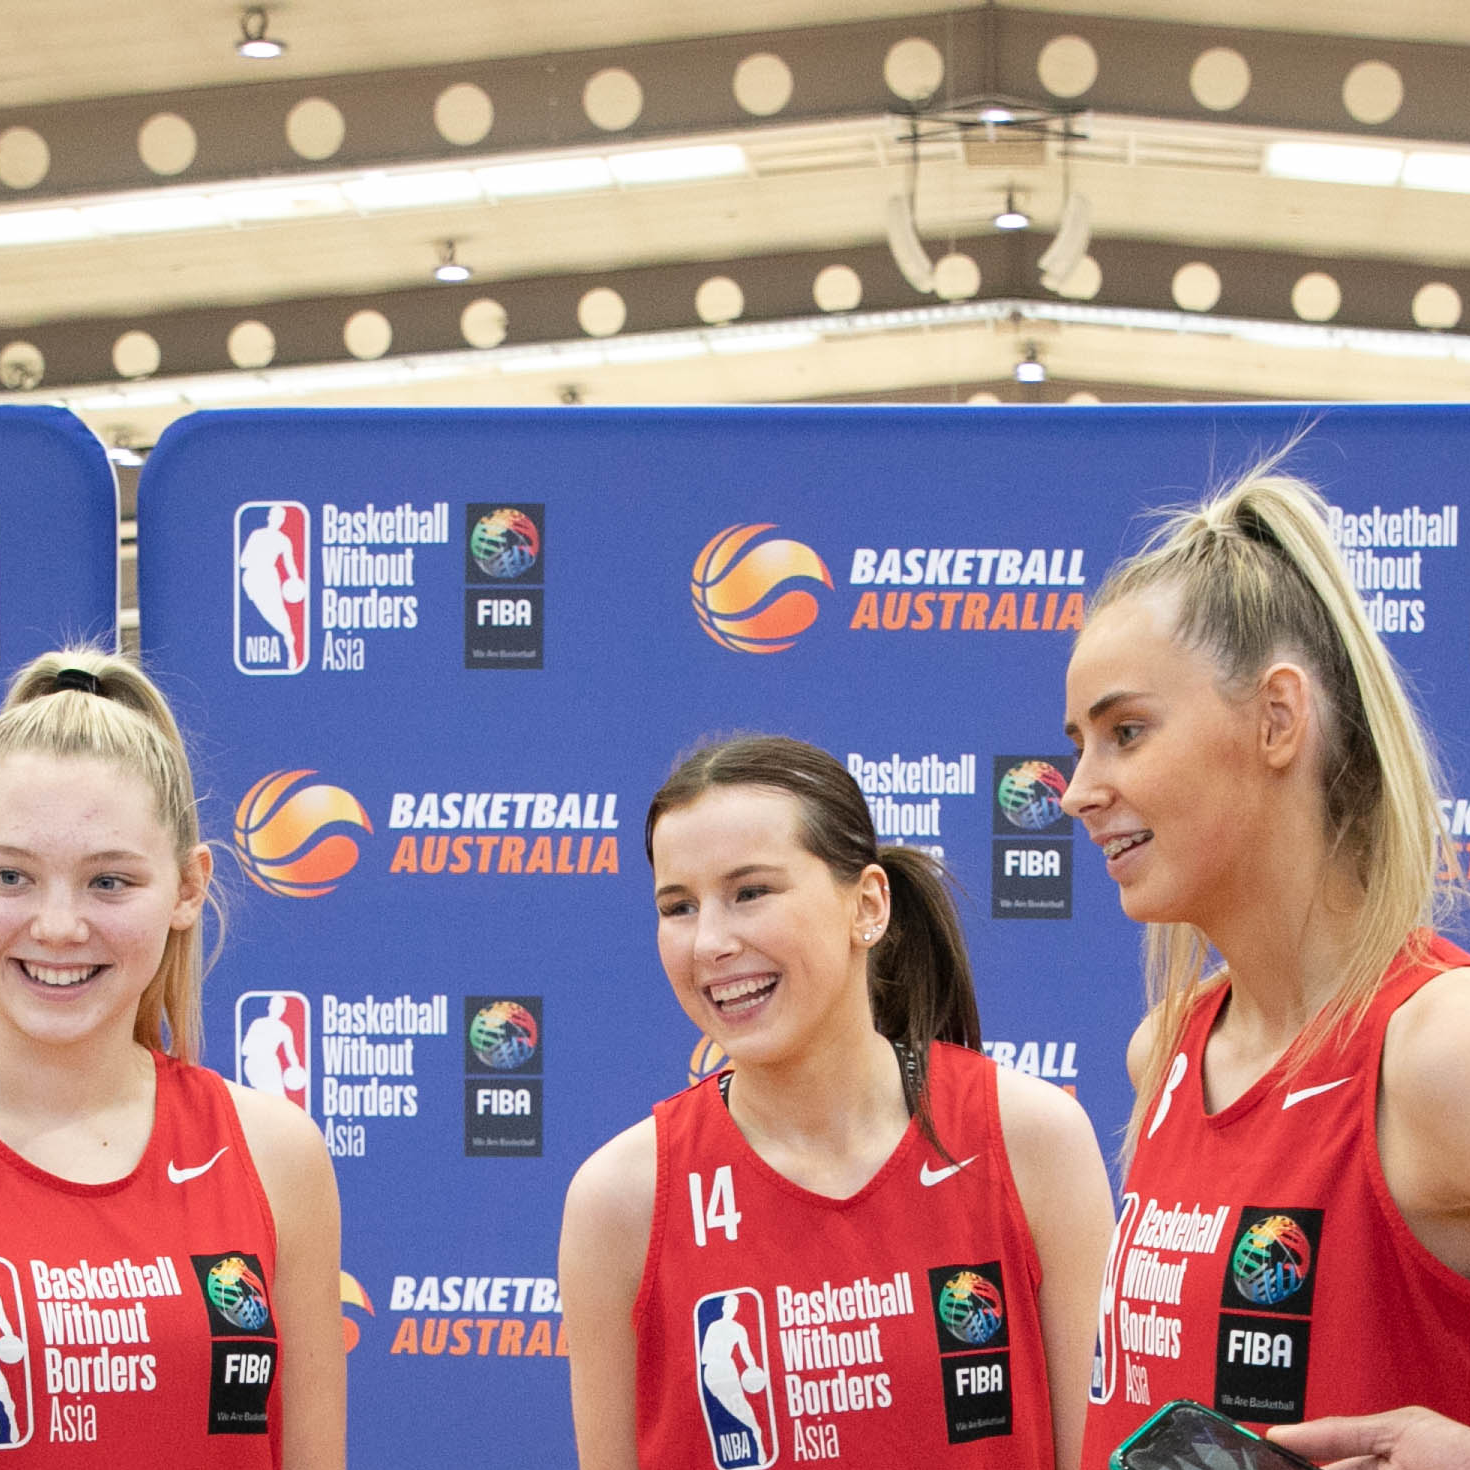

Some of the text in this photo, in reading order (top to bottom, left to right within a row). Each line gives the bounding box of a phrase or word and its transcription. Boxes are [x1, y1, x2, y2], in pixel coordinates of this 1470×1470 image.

[323, 503, 448, 544] Basketball
[1329, 505, 1458, 547] Basketball
[322, 546, 414, 586] Without
[850, 549, 1085, 584] BASKETBALL
[1346, 549, 1422, 590] ithout
[322, 588, 417, 628] Borders
[478, 599, 531, 625] FIBA
[850, 592, 1085, 630] AUSTRALIA
[246, 636, 281, 662] NBA
[322, 631, 364, 670] Asia
[389, 793, 618, 828] BASKETBALL
[869, 796, 941, 836] ithout
[390, 836, 618, 874] AUSTRALIA
[1005, 850, 1060, 876] FIBA
[323, 995, 447, 1034] Basketball
[322, 1036, 413, 1075] Without
[323, 1077, 417, 1116] Borders
[477, 1089, 530, 1114] FIBA
[324, 1119, 365, 1156] Asia
[689, 1165, 741, 1247] 14
[1133, 1199, 1229, 1254] Basketball
[31, 1257, 182, 1299] Basketball
[1123, 1248, 1188, 1306] Without
[776, 1273, 914, 1327] Basketball
[38, 1301, 149, 1345] Without
[1120, 1300, 1182, 1361] Borders
[780, 1324, 883, 1372] Without
[1228, 1329, 1292, 1368] FIBA
[46, 1351, 157, 1393] Borders
[225, 1354, 271, 1384] FIBA
[956, 1365, 1002, 1396] FIBA
[1125, 1355, 1151, 1406] Asia
[786, 1373, 892, 1417] Borders
[1249, 1397, 1295, 1411] Basketball
[49, 1397, 97, 1443] Asia
[794, 1418, 839, 1462] Asia
[720, 1432, 751, 1463] NBA
